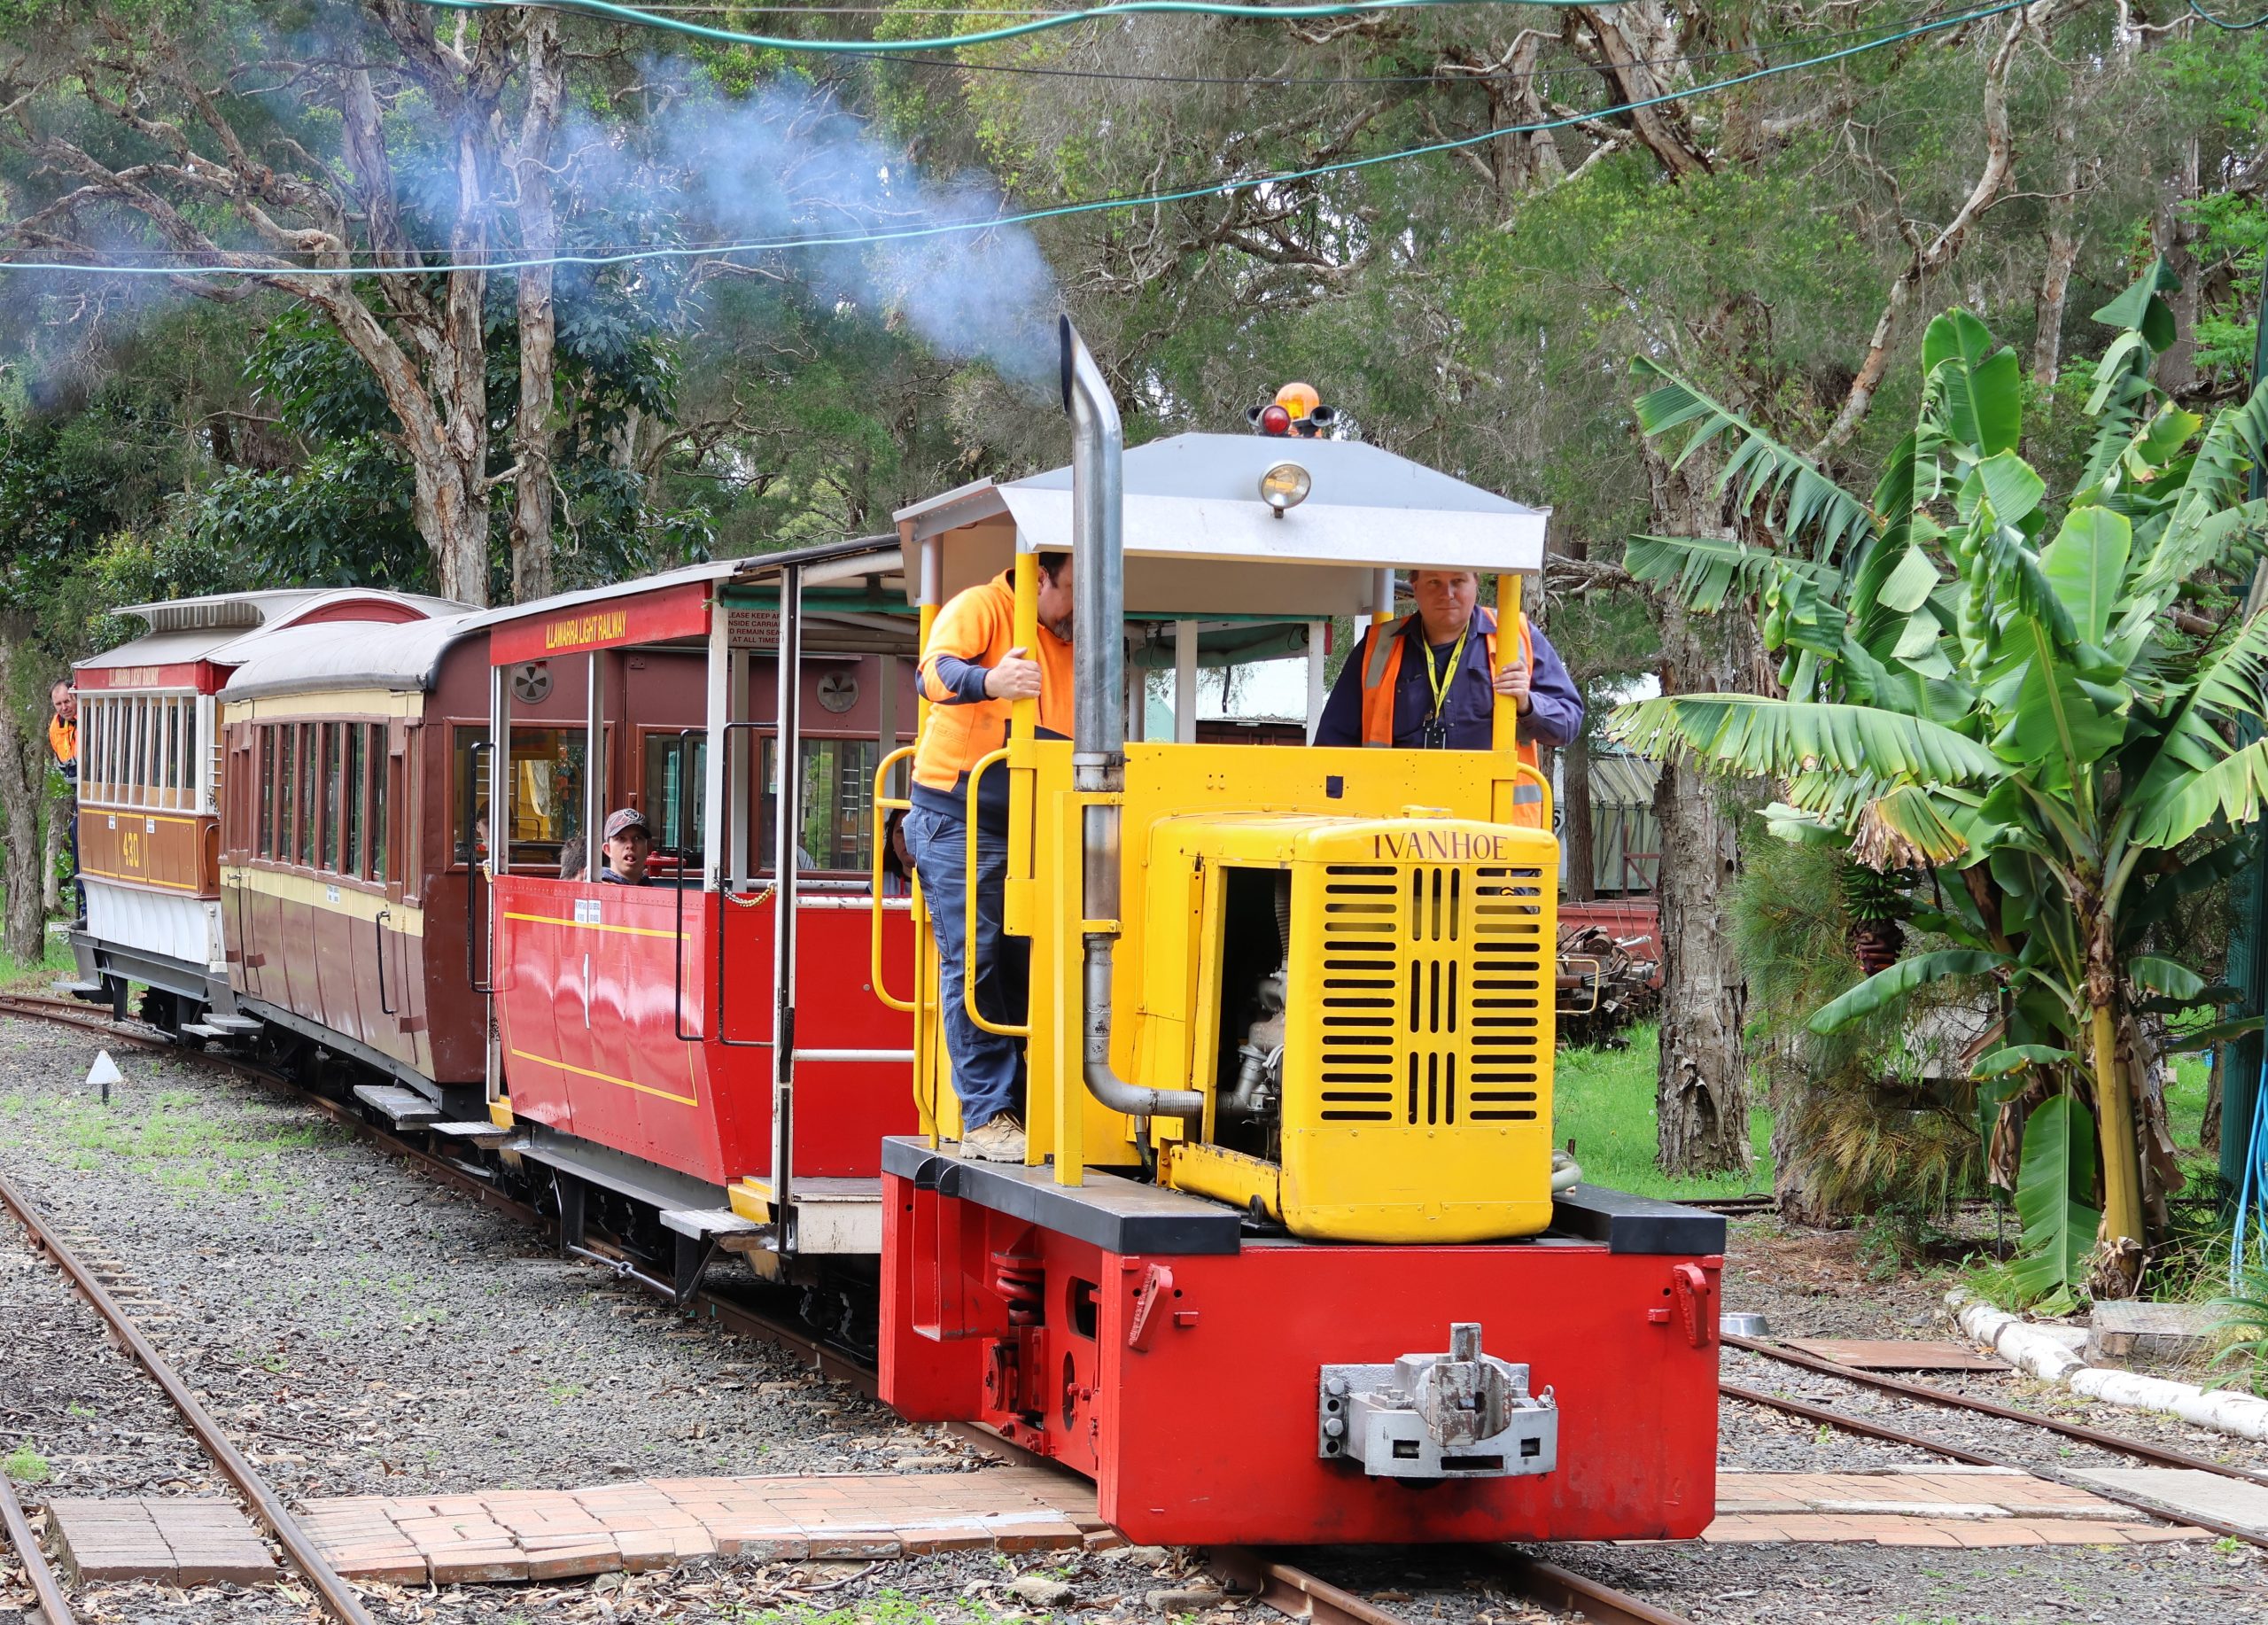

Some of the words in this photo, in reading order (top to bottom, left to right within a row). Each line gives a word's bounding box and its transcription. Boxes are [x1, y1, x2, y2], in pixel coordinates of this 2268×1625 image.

[546, 619, 579, 649] ILLAWARRA
[579, 615, 598, 644] LIGHT
[598, 610, 626, 641] RAILWAY
[123, 832, 139, 867] 430
[1373, 830, 1508, 860] IVANHOE
